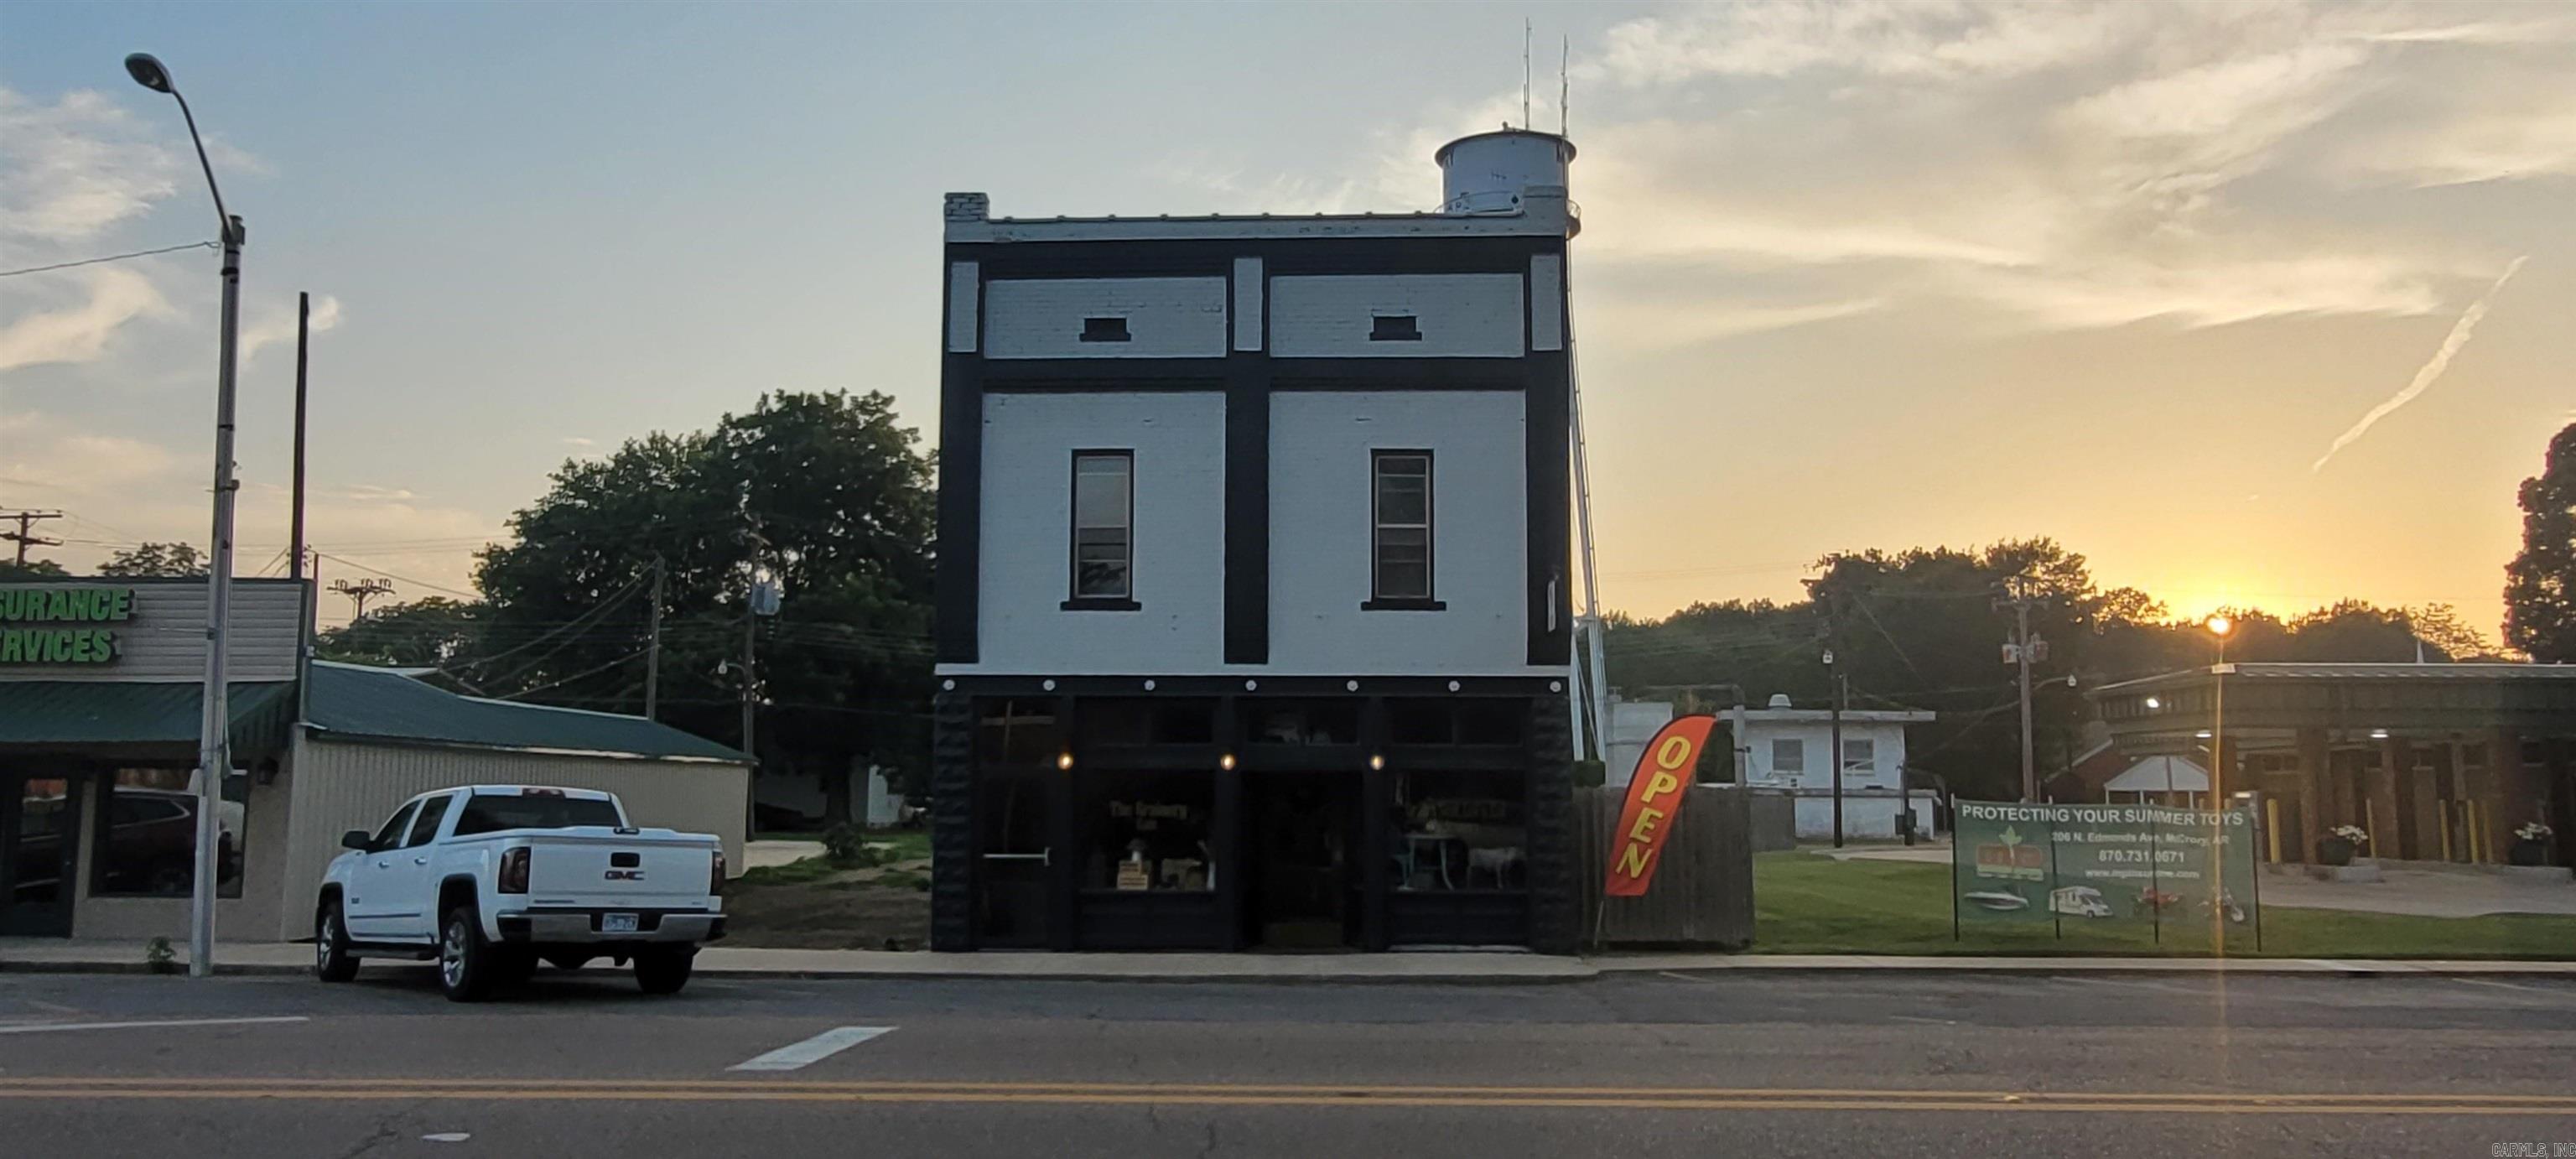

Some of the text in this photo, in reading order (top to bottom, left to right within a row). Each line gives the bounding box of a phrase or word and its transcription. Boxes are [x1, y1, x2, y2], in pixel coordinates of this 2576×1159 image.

[0, 589, 128, 621] URANCE
[0, 631, 112, 663] RVICES
[1615, 735, 1691, 879] OPEN
[1961, 804, 2244, 827] PROTECTING YOUR SUMMER TOYS
[605, 871, 645, 881] GMC
